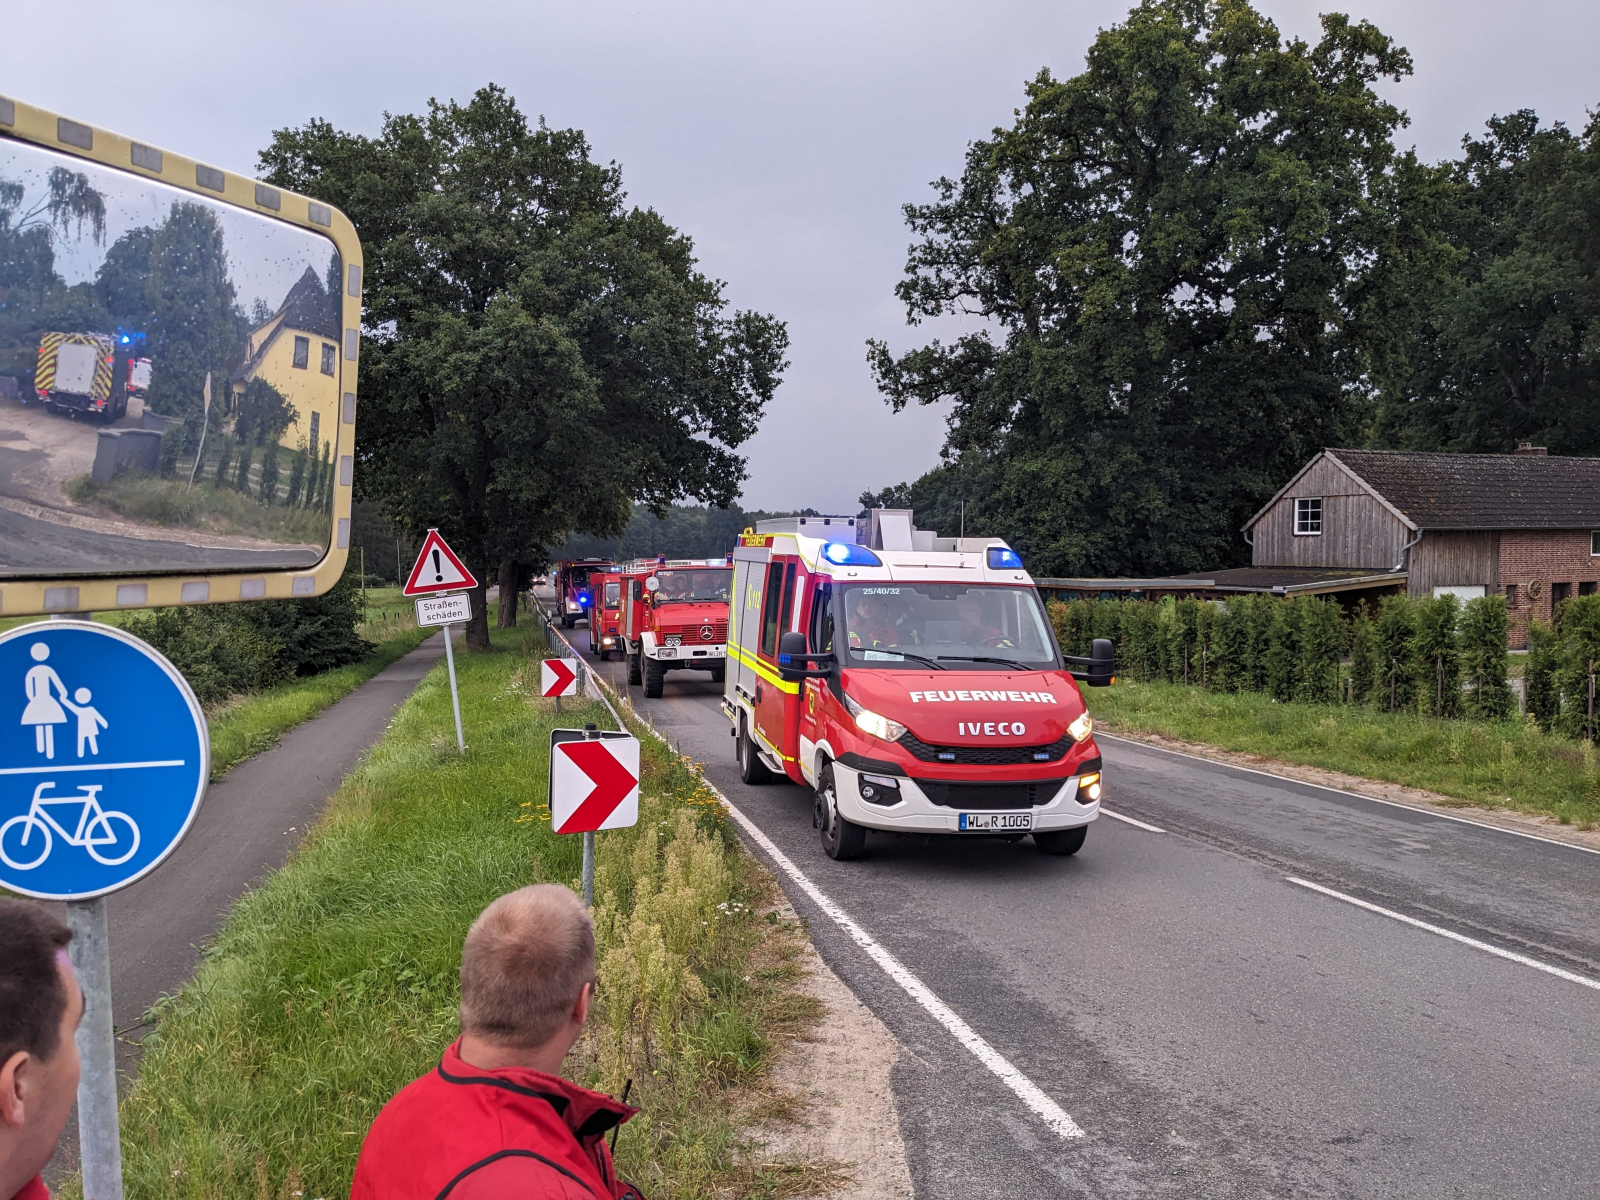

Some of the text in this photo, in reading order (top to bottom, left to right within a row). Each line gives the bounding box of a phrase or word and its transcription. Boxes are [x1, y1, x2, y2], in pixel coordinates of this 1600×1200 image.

[862, 587, 901, 595] 25/40/32
[423, 600, 463, 611] Straßen-
[426, 610, 463, 621] schäden
[909, 690, 1058, 704] FEUERWEHR
[958, 722, 1026, 736] IVECO
[968, 816, 983, 827] WL
[991, 816, 998, 827] R
[1001, 815, 1030, 827] 1005
